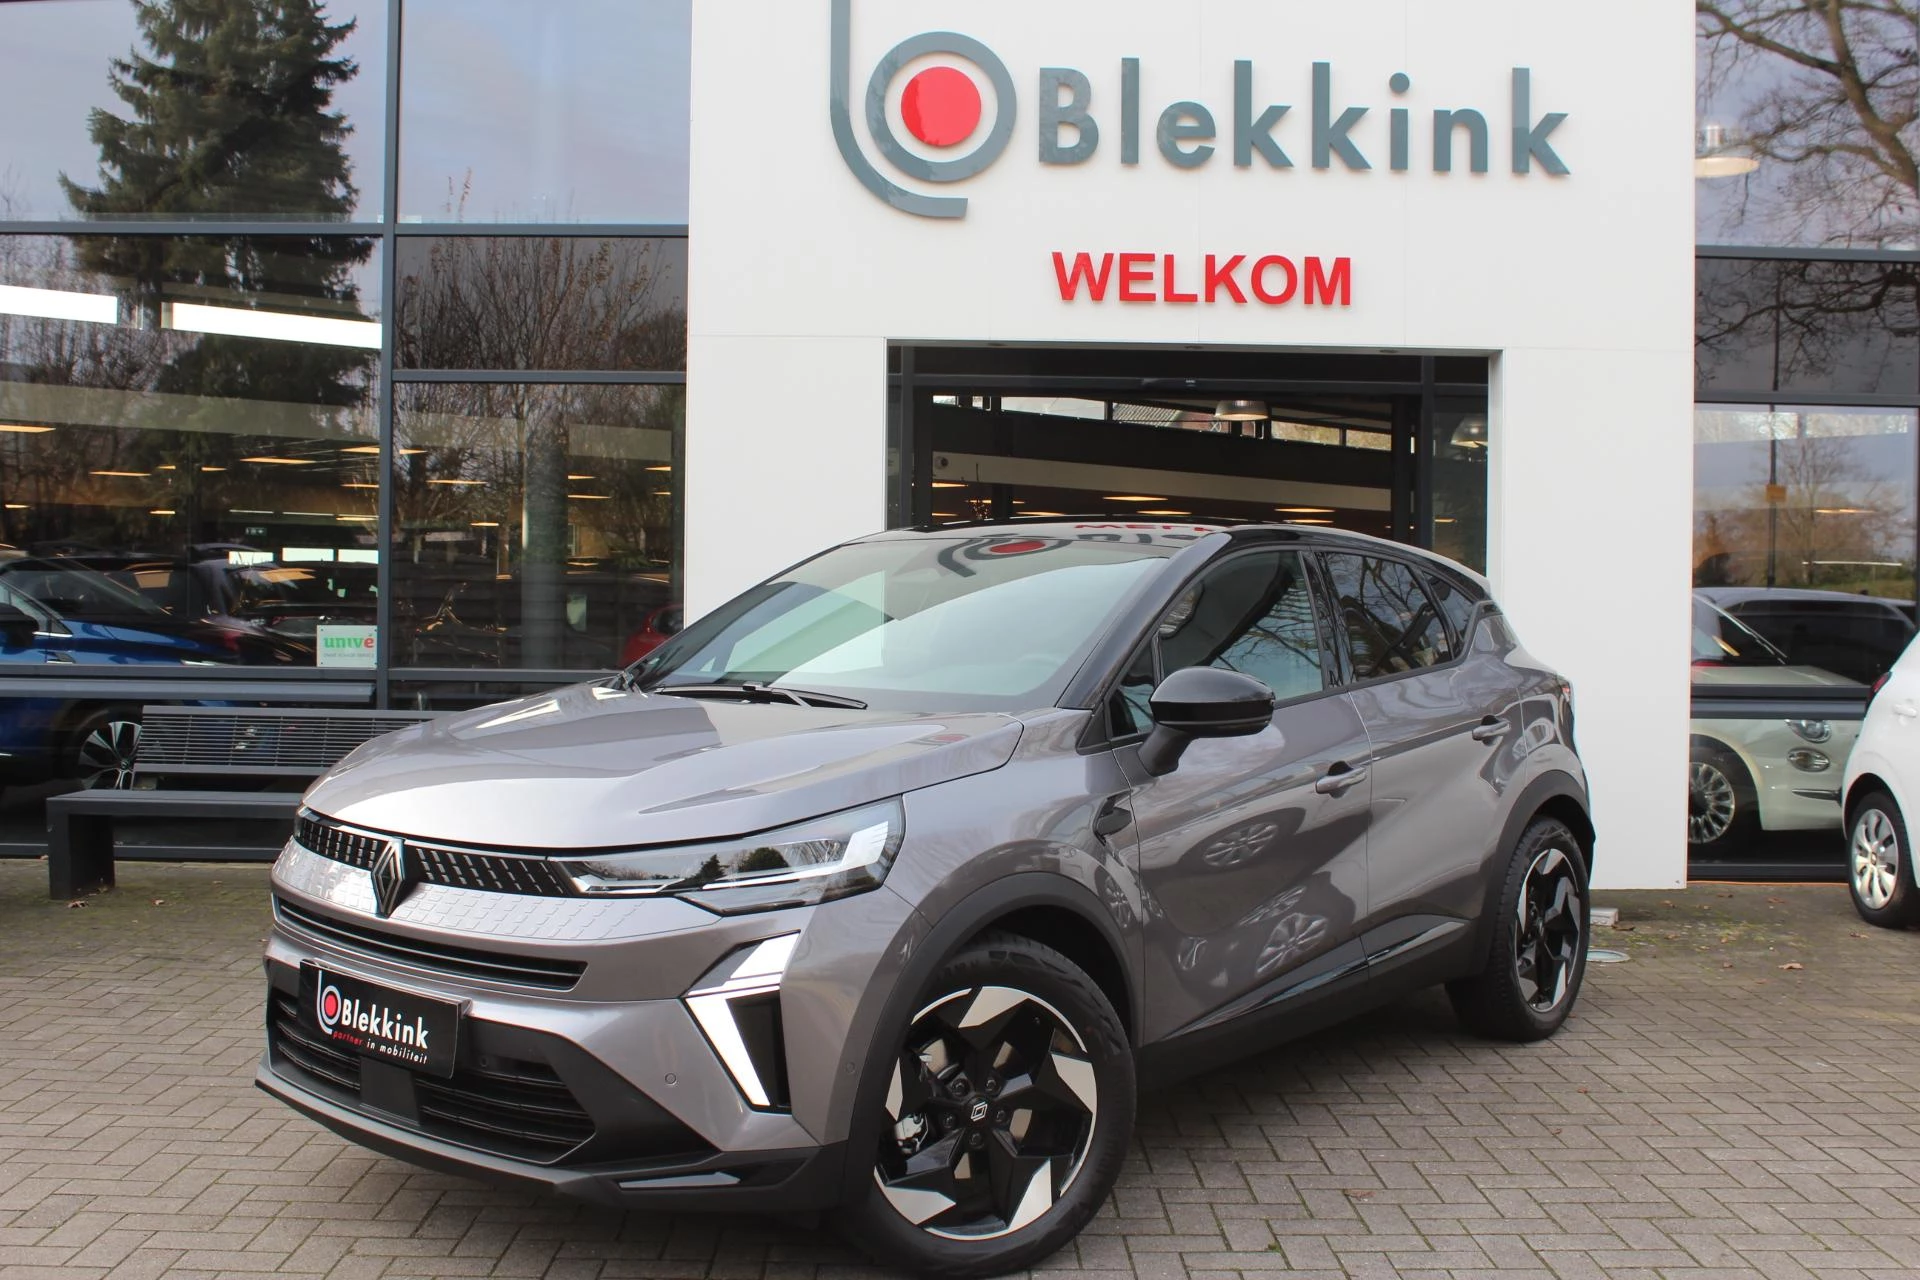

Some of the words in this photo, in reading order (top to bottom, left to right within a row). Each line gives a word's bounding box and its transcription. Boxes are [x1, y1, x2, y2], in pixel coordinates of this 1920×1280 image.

[1039, 57, 1571, 175] Blekkink
[1052, 251, 1351, 306] WELKOM
[332, 1030, 363, 1046] partner
[366, 1037, 375, 1050] in
[379, 1044, 428, 1065] mobiliteit
[341, 998, 429, 1049] Blekkink
